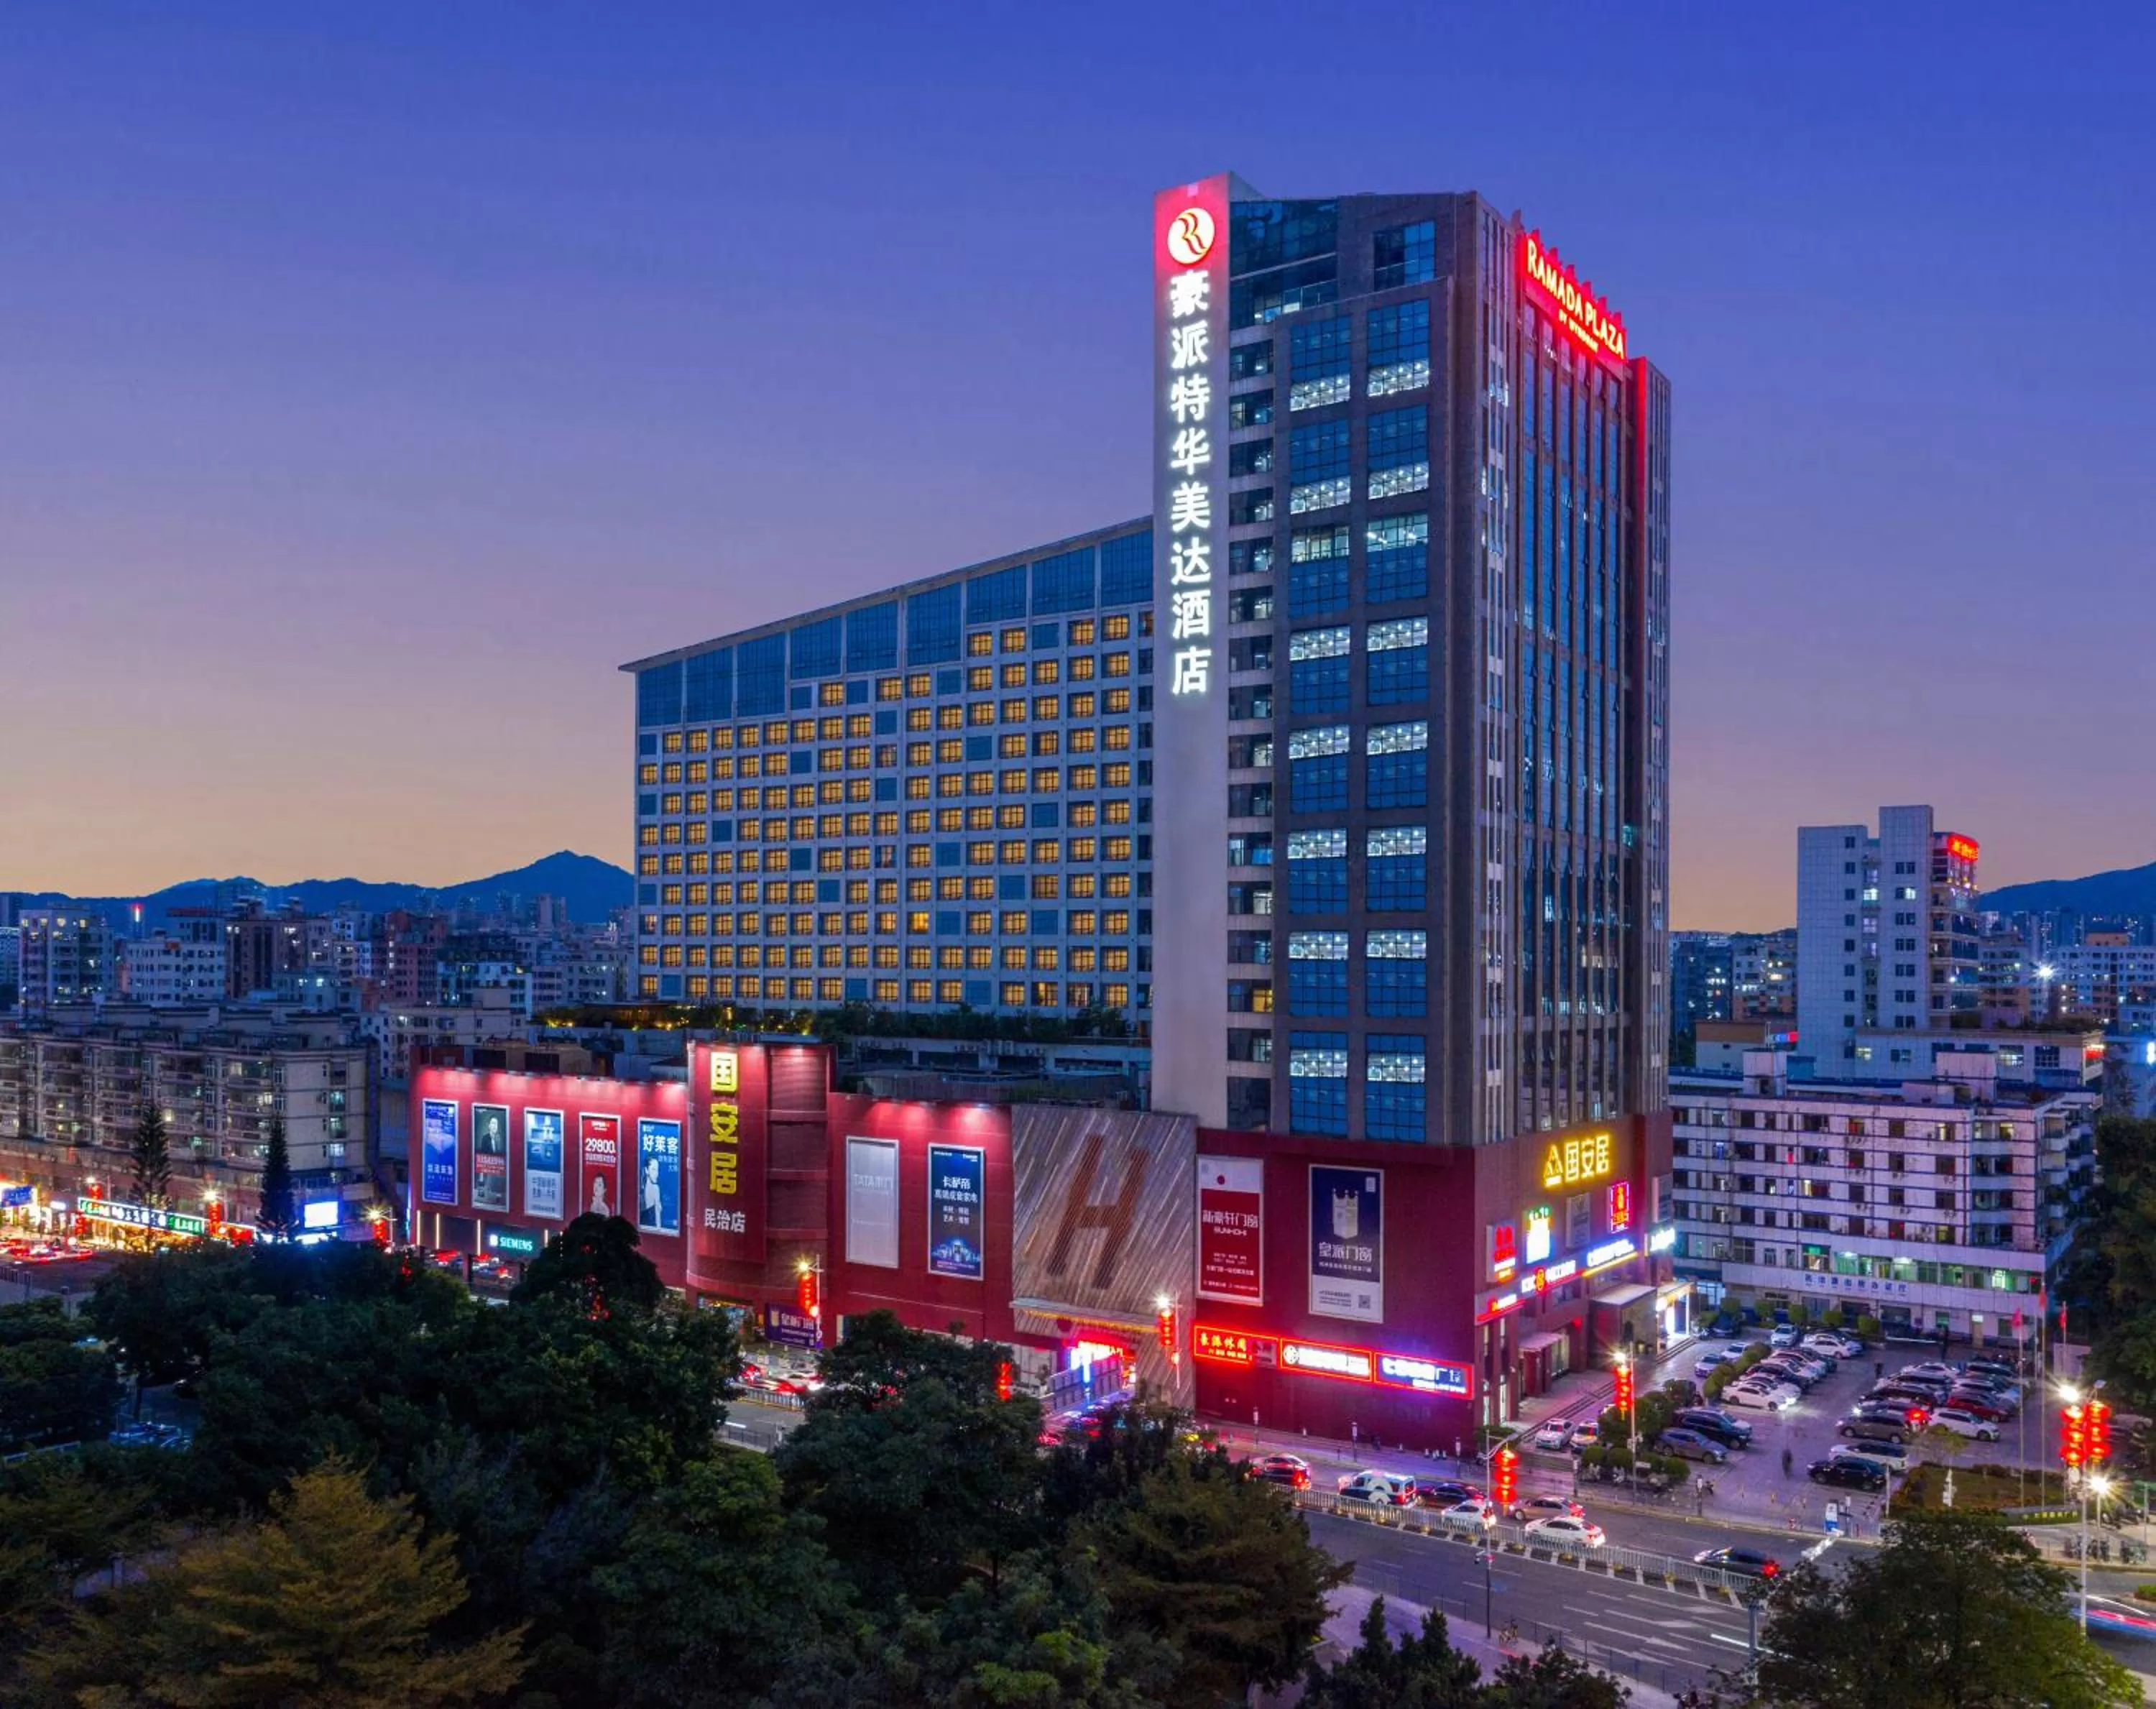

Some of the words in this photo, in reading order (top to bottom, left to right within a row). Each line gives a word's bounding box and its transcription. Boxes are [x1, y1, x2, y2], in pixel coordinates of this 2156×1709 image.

[1527, 238, 1583, 322] RAMADA
[1585, 300, 1624, 360] PLAZA
[1169, 270, 1212, 696] 豪派特华美达酒店
[642, 1133, 678, 1154] 好莱客
[709, 1051, 739, 1195] 国安居
[1565, 1134, 1610, 1182] 国安居
[704, 1208, 746, 1233] 民治店
